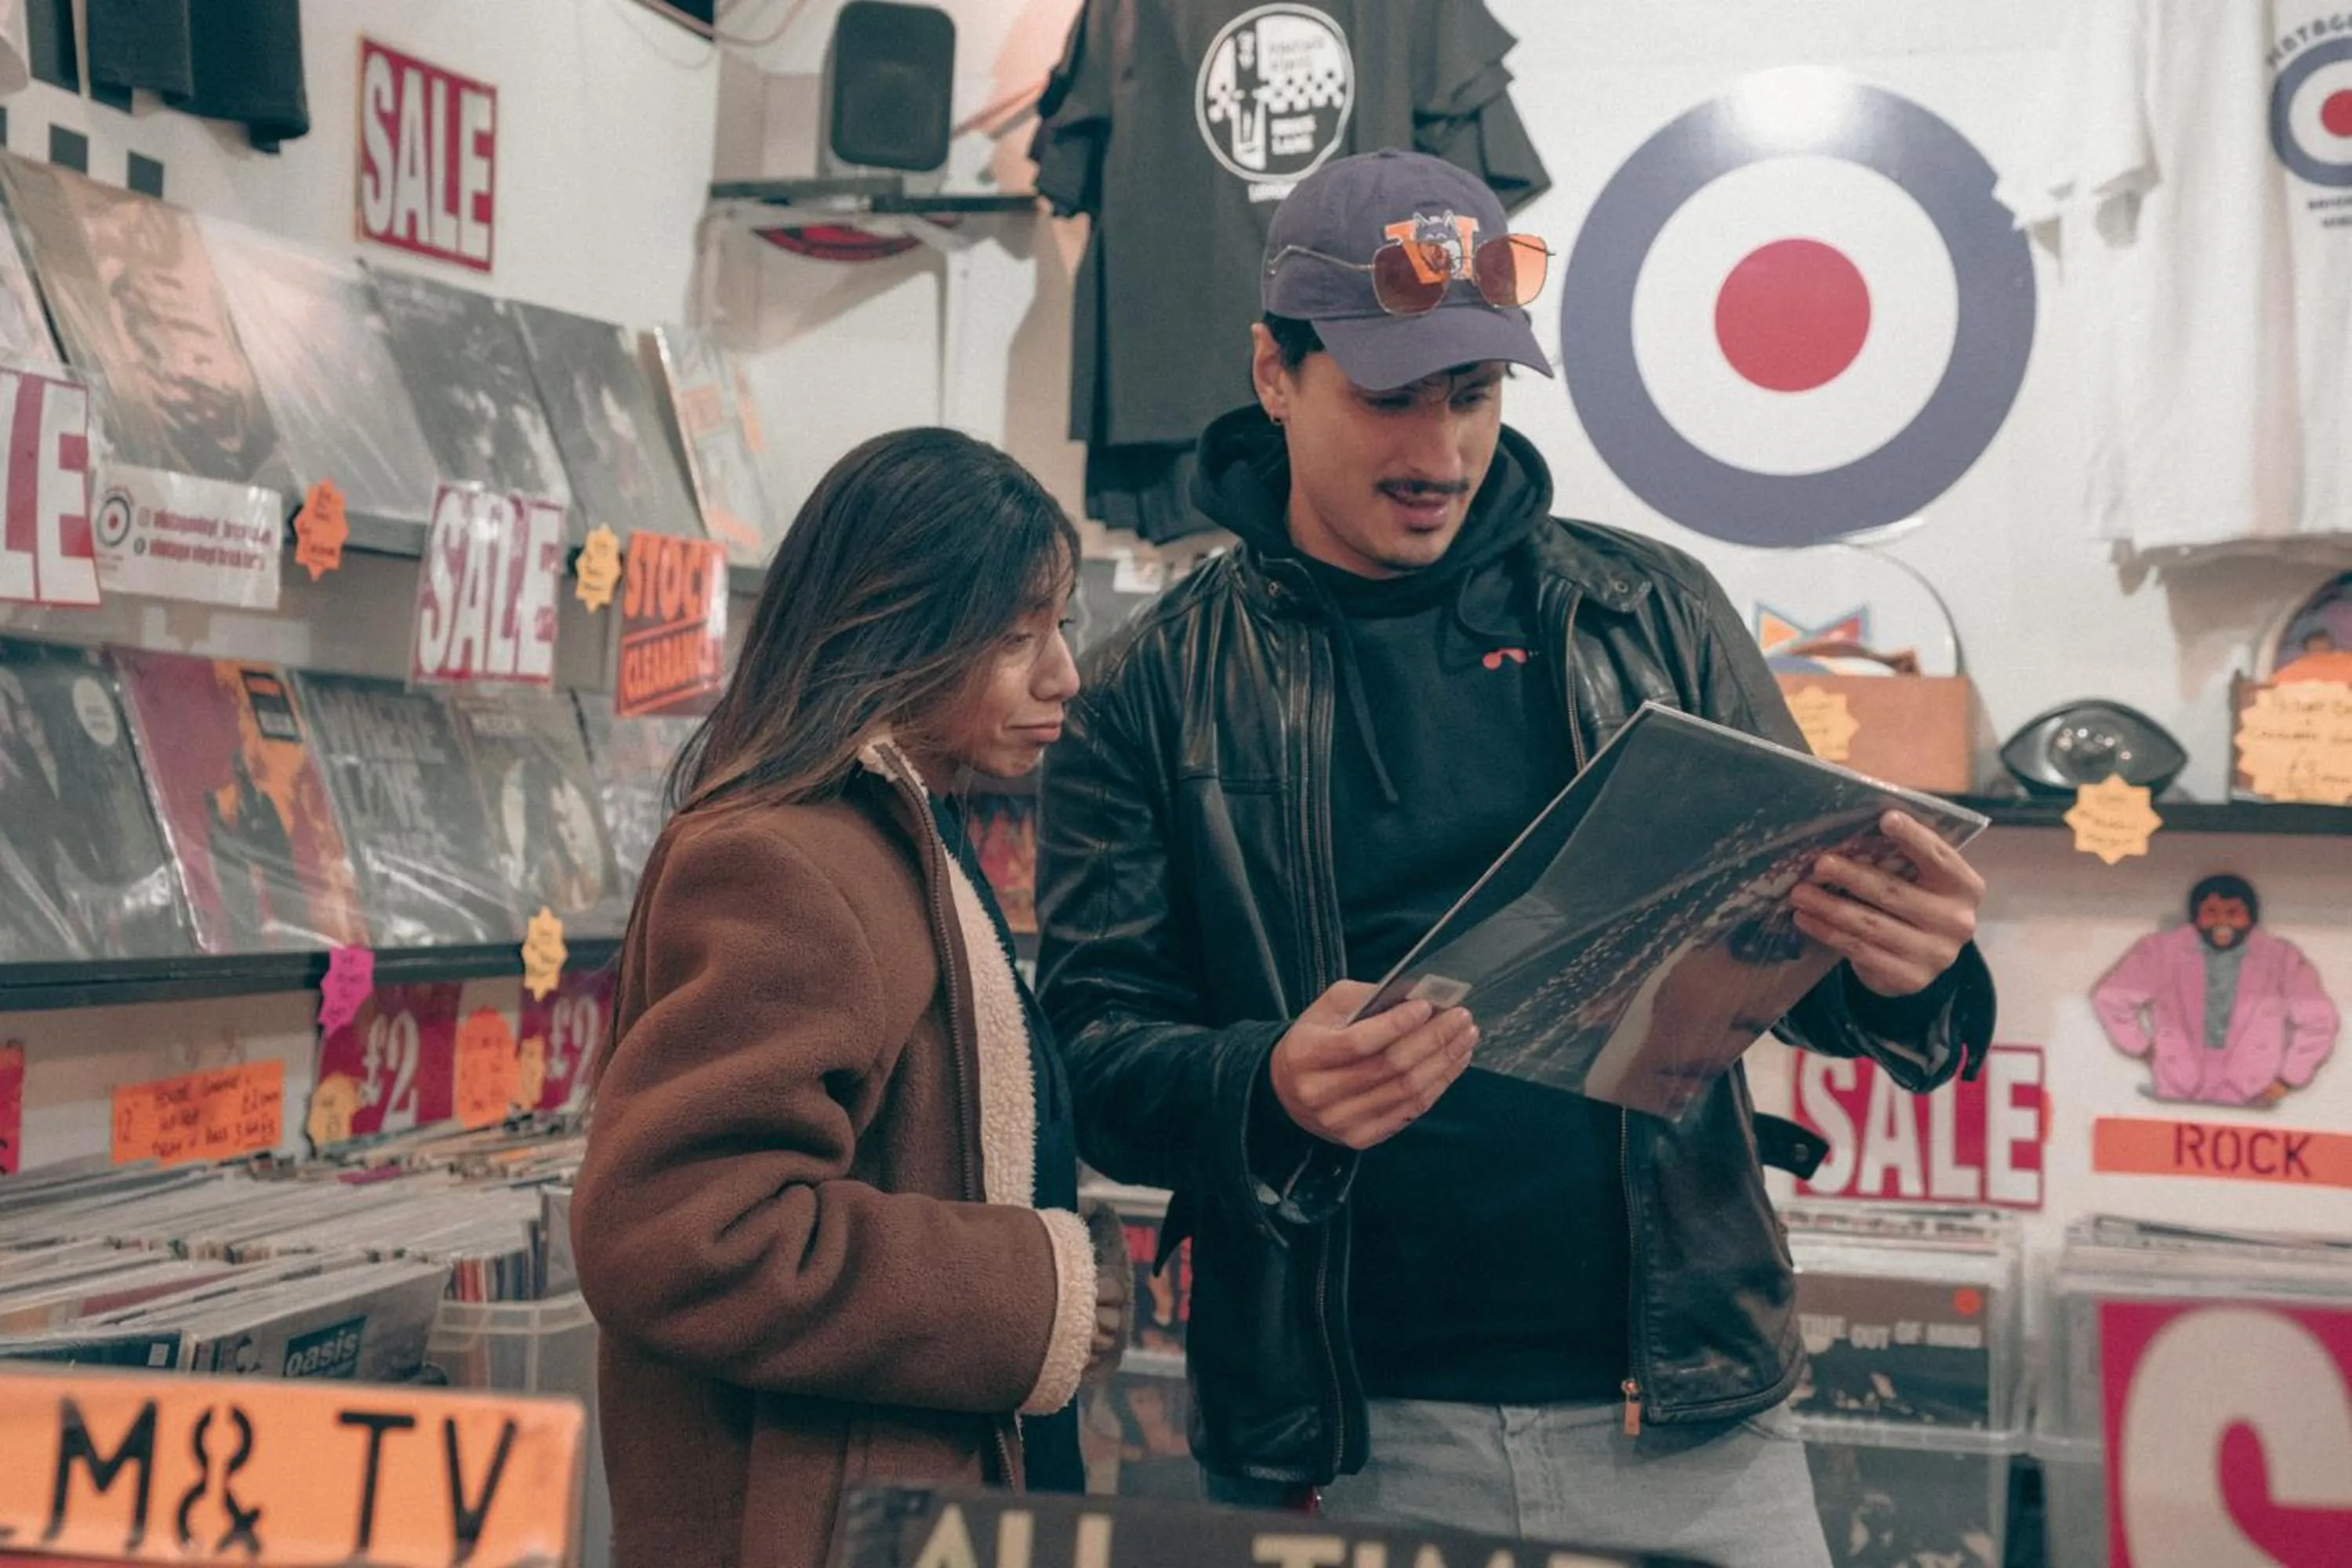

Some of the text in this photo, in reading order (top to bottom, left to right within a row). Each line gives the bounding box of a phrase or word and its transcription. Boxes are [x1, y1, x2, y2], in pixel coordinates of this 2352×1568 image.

[363, 52, 492, 261] SALE
[419, 488, 563, 676] SALE
[360, 1010, 420, 1134] £2
[1800, 1054, 2041, 1204] SALE
[2173, 1123, 2313, 1178] ROCK
[286, 1329, 358, 1377] oasis
[336, 1411, 518, 1568] TV
